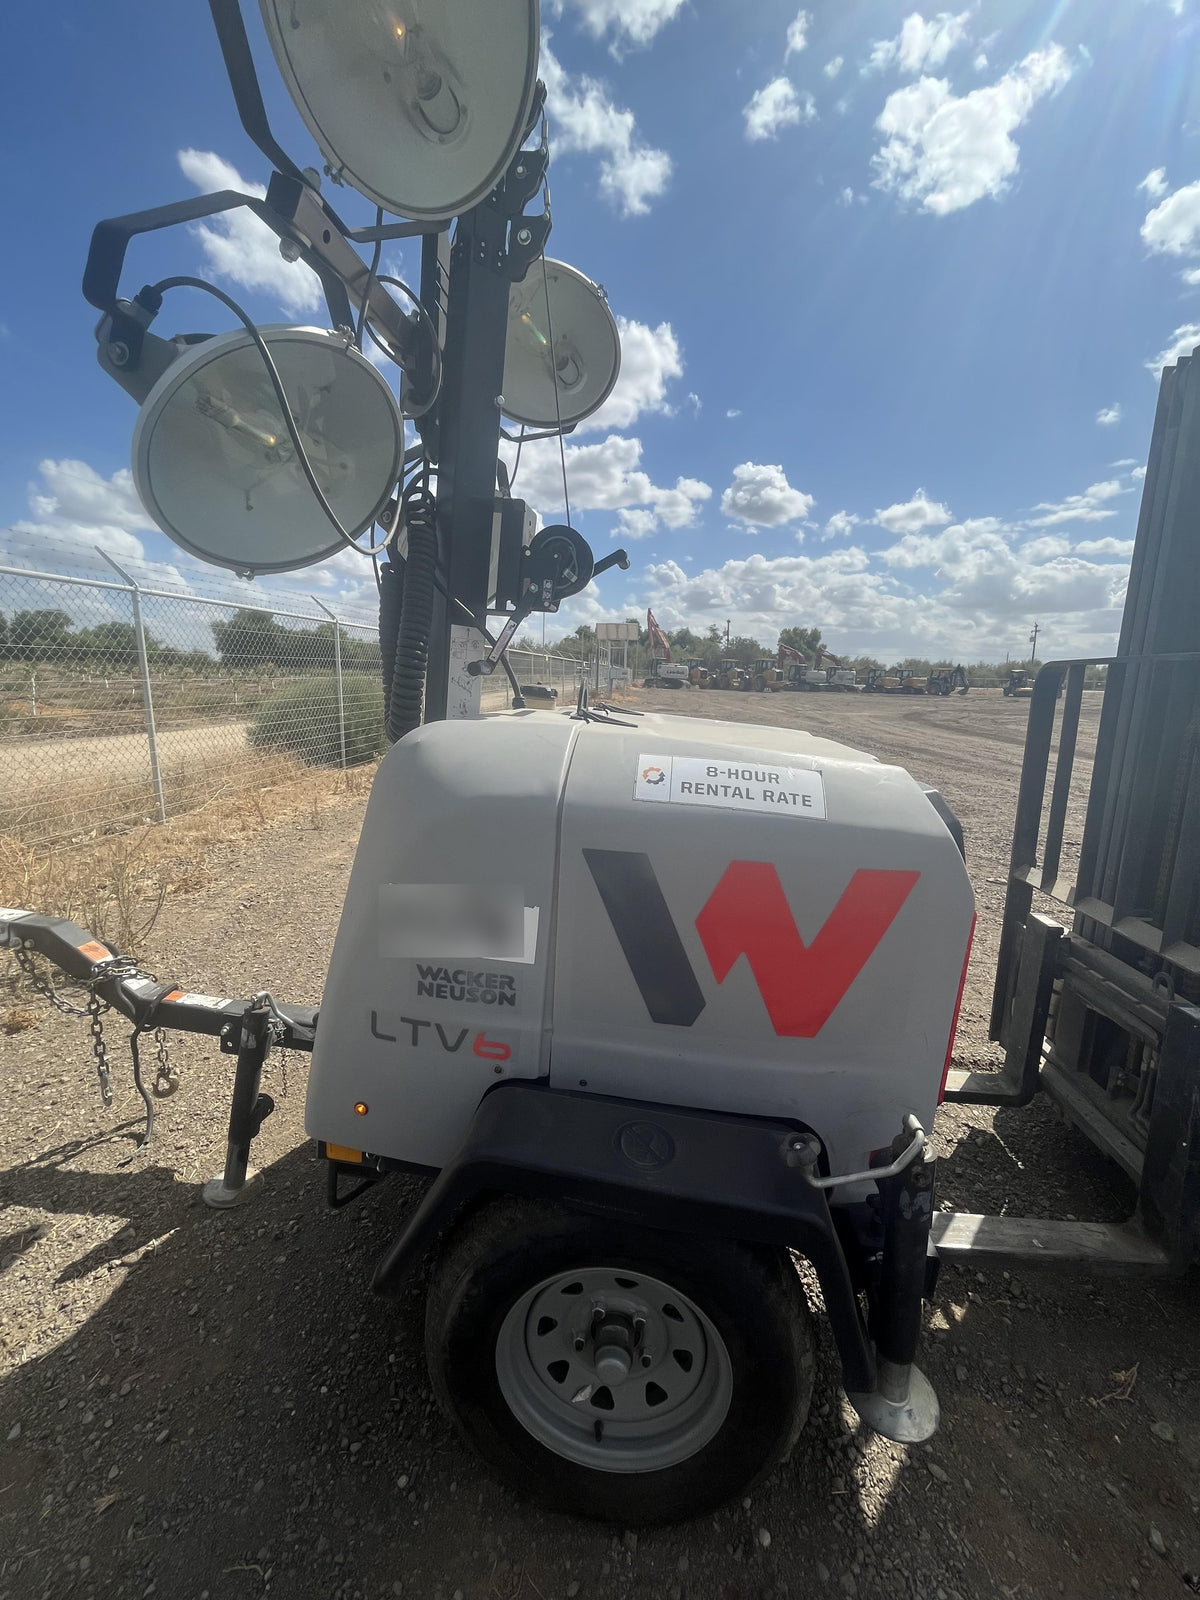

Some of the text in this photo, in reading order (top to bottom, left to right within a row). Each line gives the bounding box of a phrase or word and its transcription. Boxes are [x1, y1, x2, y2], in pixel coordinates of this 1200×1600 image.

[706, 766, 780, 784] 8-HOUR
[680, 781, 813, 808] RENTAL RATE
[416, 963, 516, 991] WACKER
[417, 980, 517, 1007] NEUSON
[371, 1010, 512, 1061] LTV6
